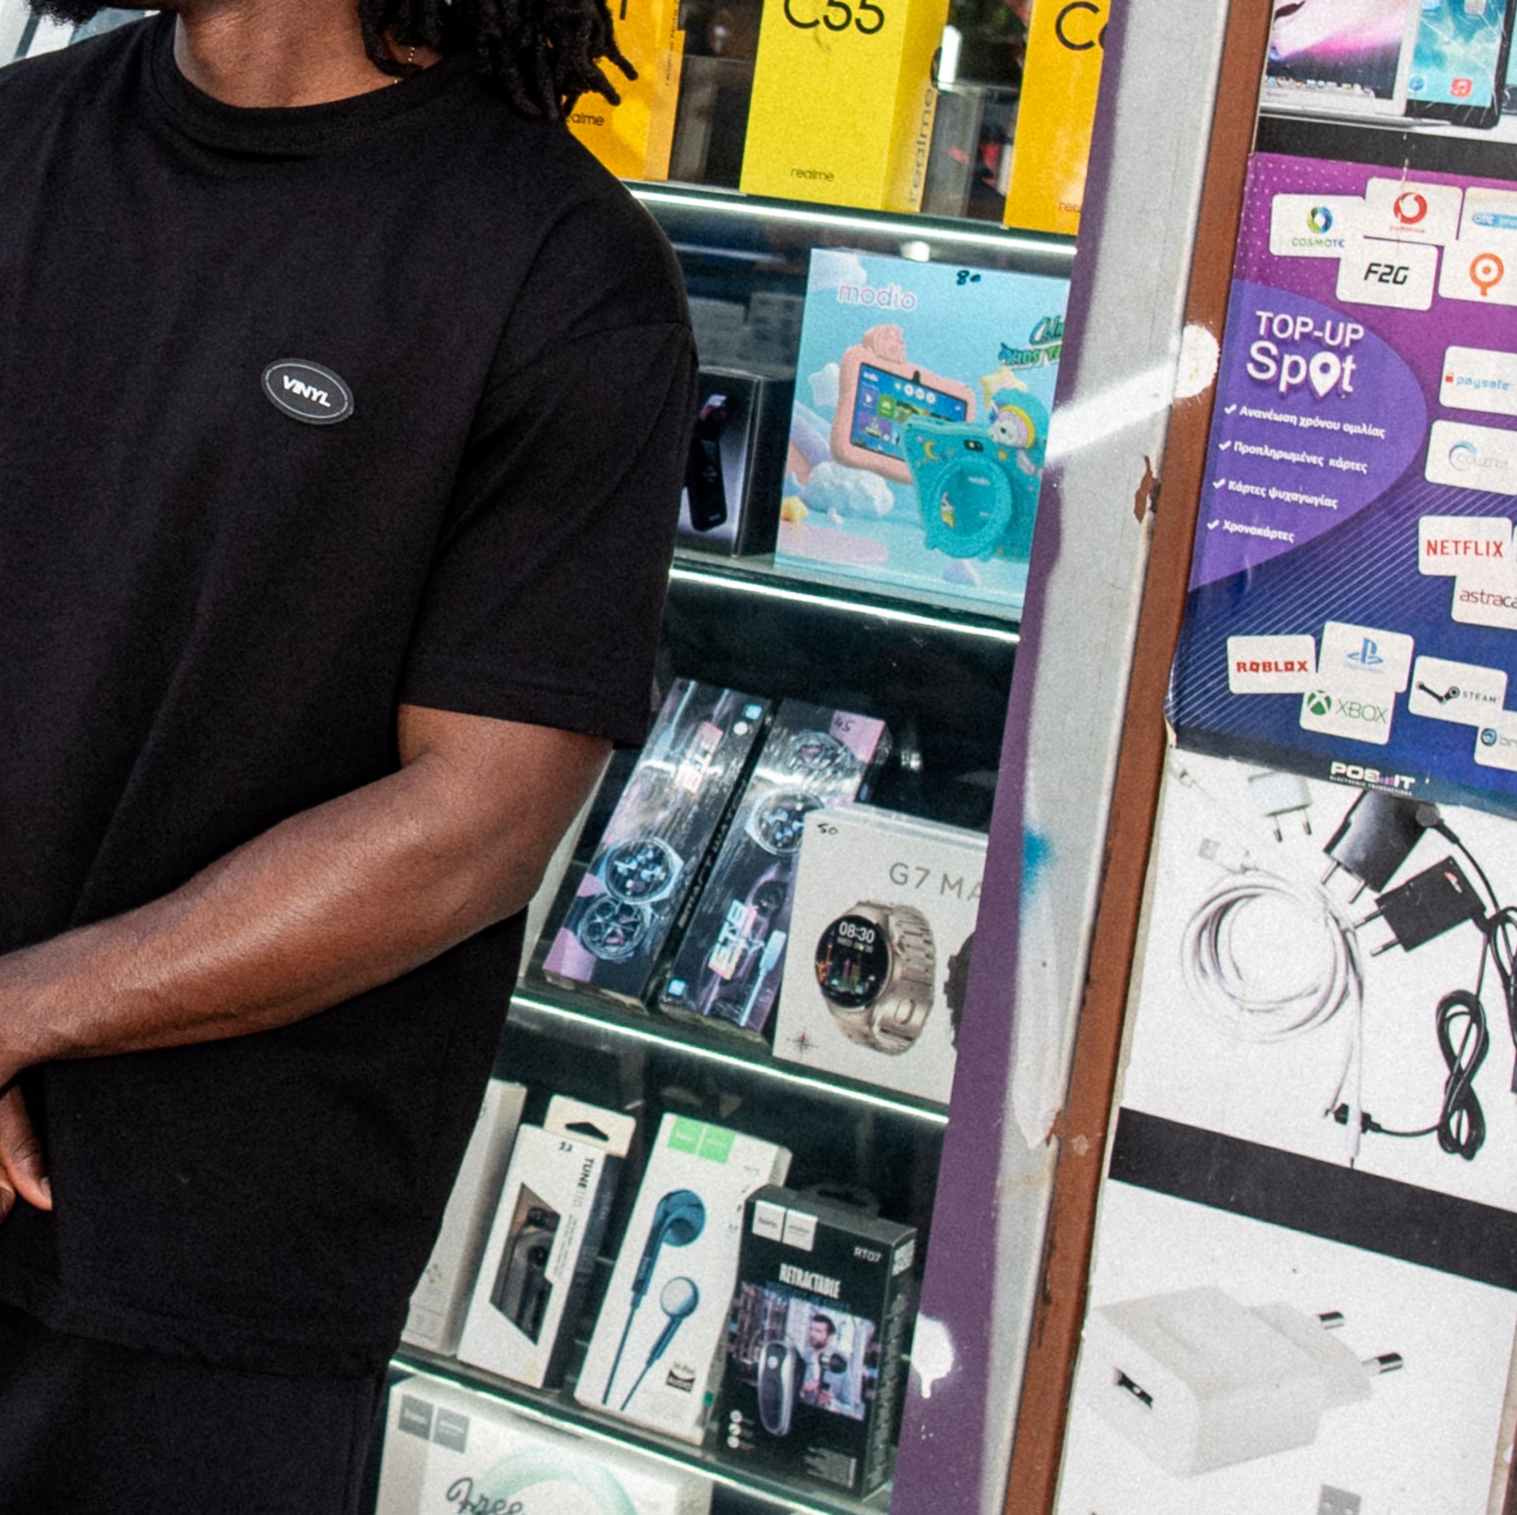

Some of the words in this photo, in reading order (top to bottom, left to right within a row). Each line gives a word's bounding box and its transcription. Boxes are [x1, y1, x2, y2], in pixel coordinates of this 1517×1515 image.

[909, 88, 935, 206] realme
[790, 167, 835, 184] realme
[1292, 237, 1346, 249] COSMOTE
[1364, 262, 1410, 285] F2G
[837, 284, 917, 311] modio
[1256, 310, 1365, 348] TOP-UP
[1246, 341, 1358, 399] Spot
[283, 375, 331, 407] VINYL
[1239, 405, 1297, 425] Ανανέωση
[1299, 416, 1341, 431] χρόνου
[1343, 420, 1386, 439] ομιλίας
[1233, 441, 1324, 466] Προπληρωμένες
[1328, 457, 1369, 474] κάρτες
[1228, 481, 1267, 497] Κάρτες
[1269, 487, 1339, 510] ψυχαγωγίας
[1222, 519, 1295, 544] Χρονοκάρτες
[1426, 539, 1504, 559] NETFLIX
[1236, 660, 1309, 674] ROBLOX
[1462, 690, 1497, 705] STEAM
[1335, 703, 1389, 725] XBOX
[889, 862, 929, 889] G7
[838, 920, 876, 944] 08:30
[580, 1157, 595, 1189] TUNE
[853, 1246, 883, 1264] RT07
[779, 1263, 843, 1300] RETRACTABLE
